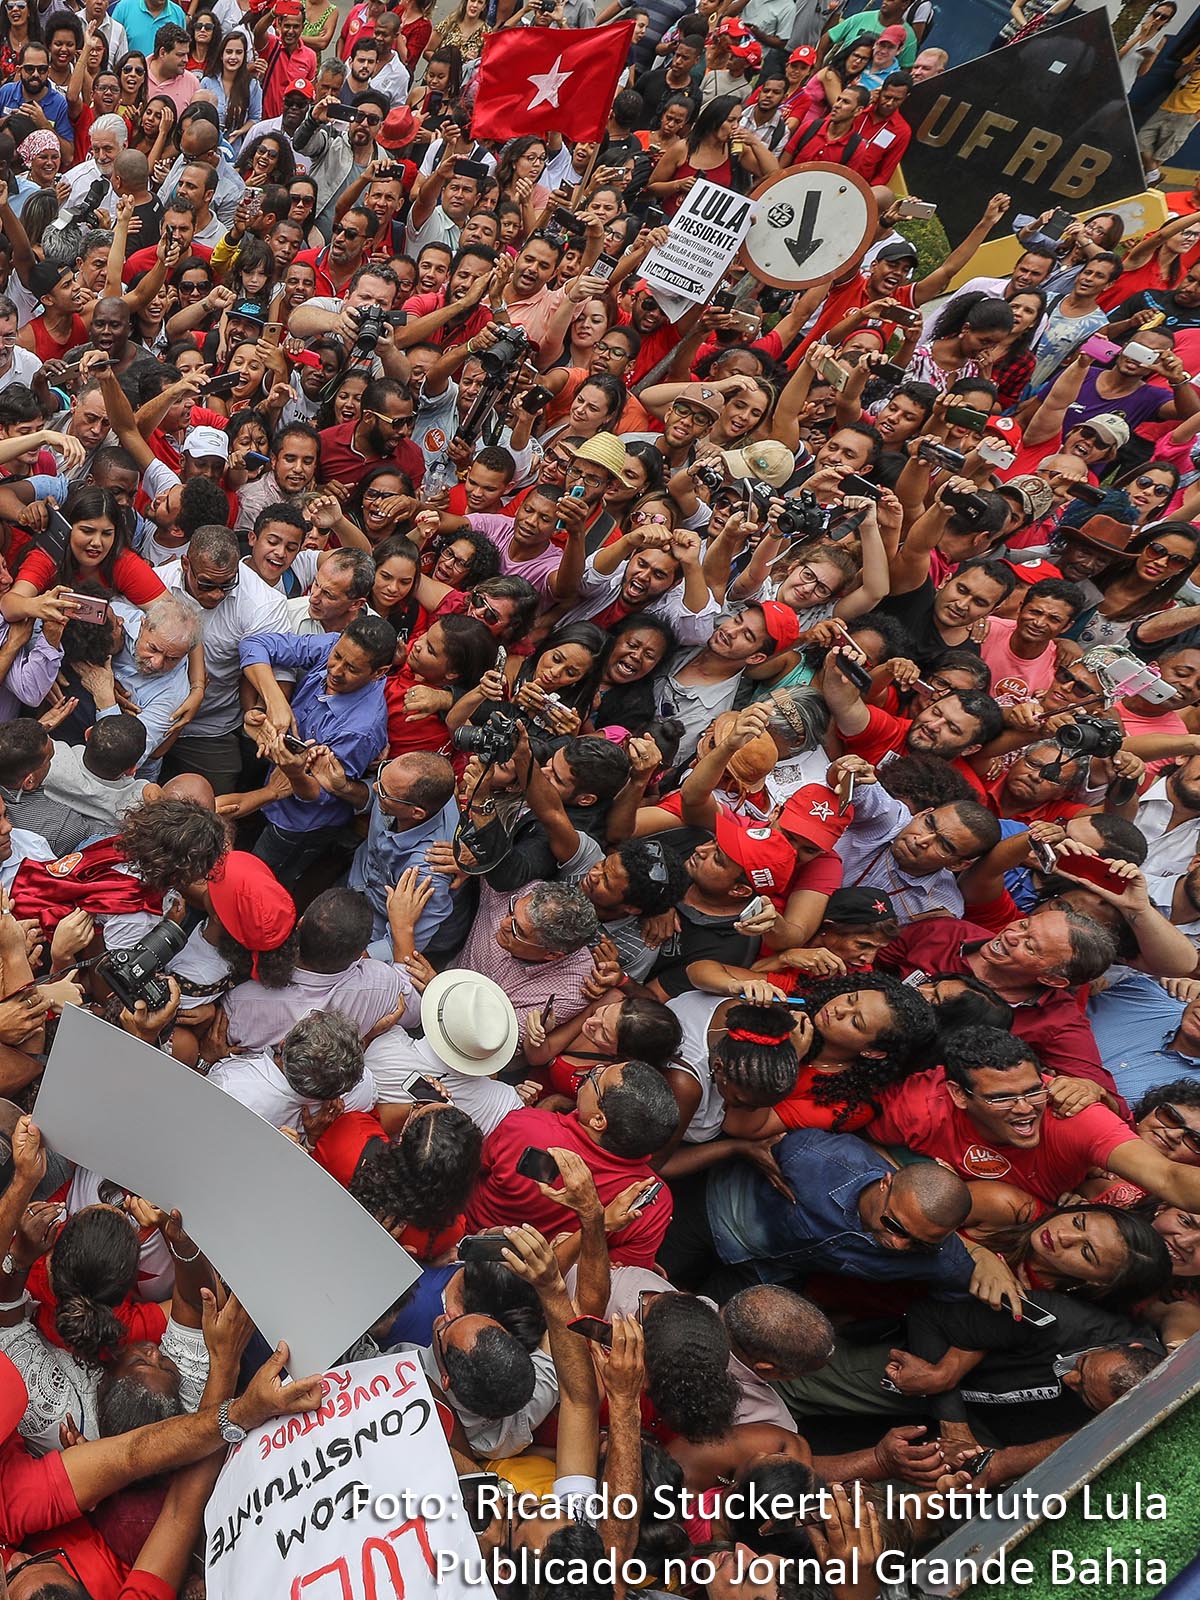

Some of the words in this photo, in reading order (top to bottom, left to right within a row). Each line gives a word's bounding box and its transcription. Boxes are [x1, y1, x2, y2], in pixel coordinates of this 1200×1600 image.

[916, 94, 1112, 199] UFRB
[688, 185, 751, 234] LULA
[674, 214, 738, 252] PRESIDENTE
[656, 249, 689, 269] TRABALHISTA
[666, 242, 687, 257] ANULAR
[689, 253, 714, 268] REFORMA
[679, 234, 714, 256] CONSTITUINTE
[711, 248, 726, 261] PARA
[665, 272, 693, 290] PETISTA
[1001, 679, 1028, 696] LULA
[259, 1360, 417, 1460] JUVENTUDE
